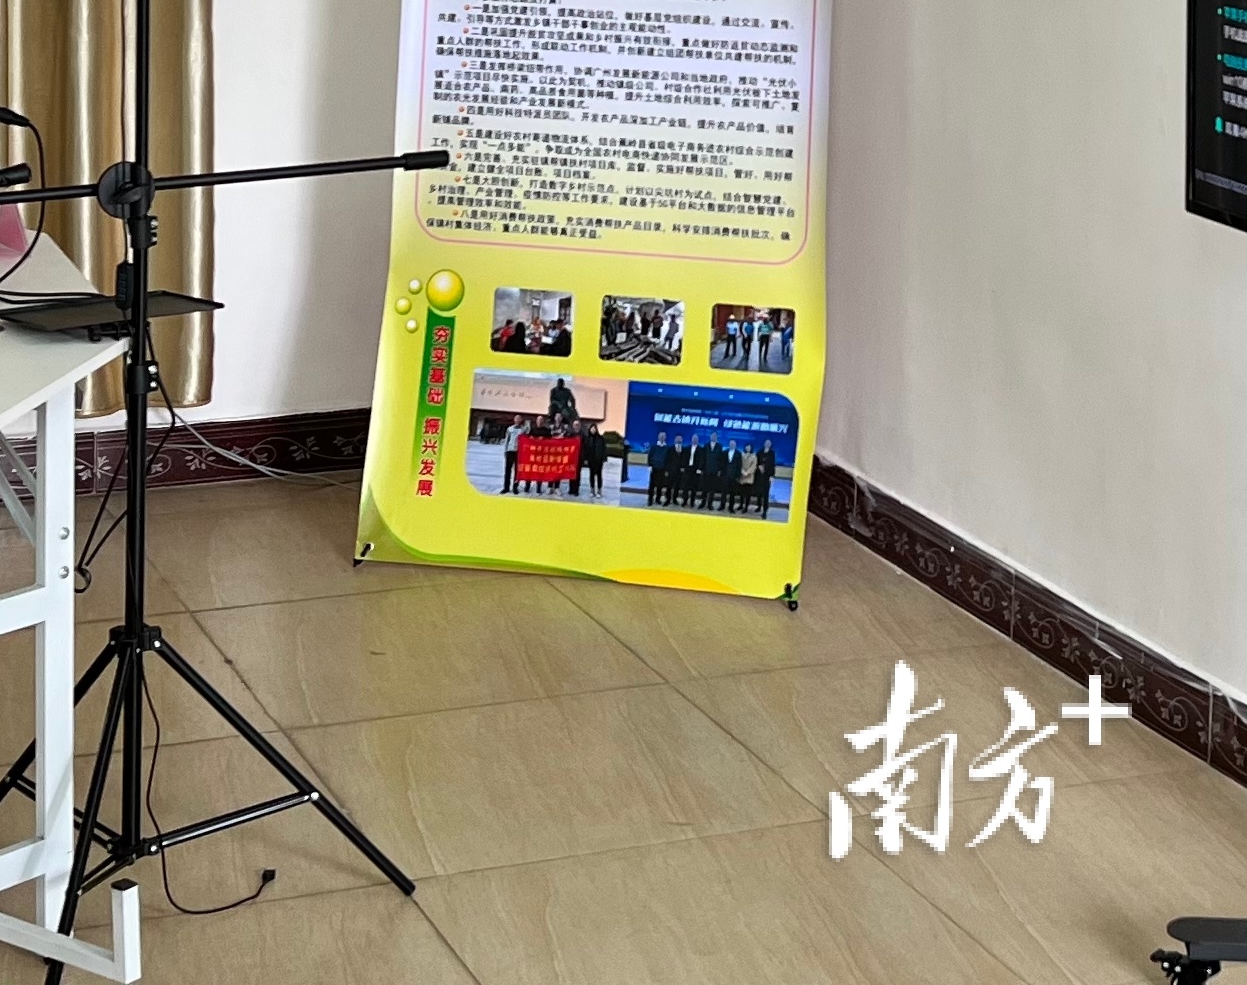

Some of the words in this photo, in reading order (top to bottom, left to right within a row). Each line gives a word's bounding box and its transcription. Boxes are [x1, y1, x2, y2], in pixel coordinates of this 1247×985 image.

[426, 326, 451, 406] 夯实基础
[415, 418, 442, 497] 振兴发展
